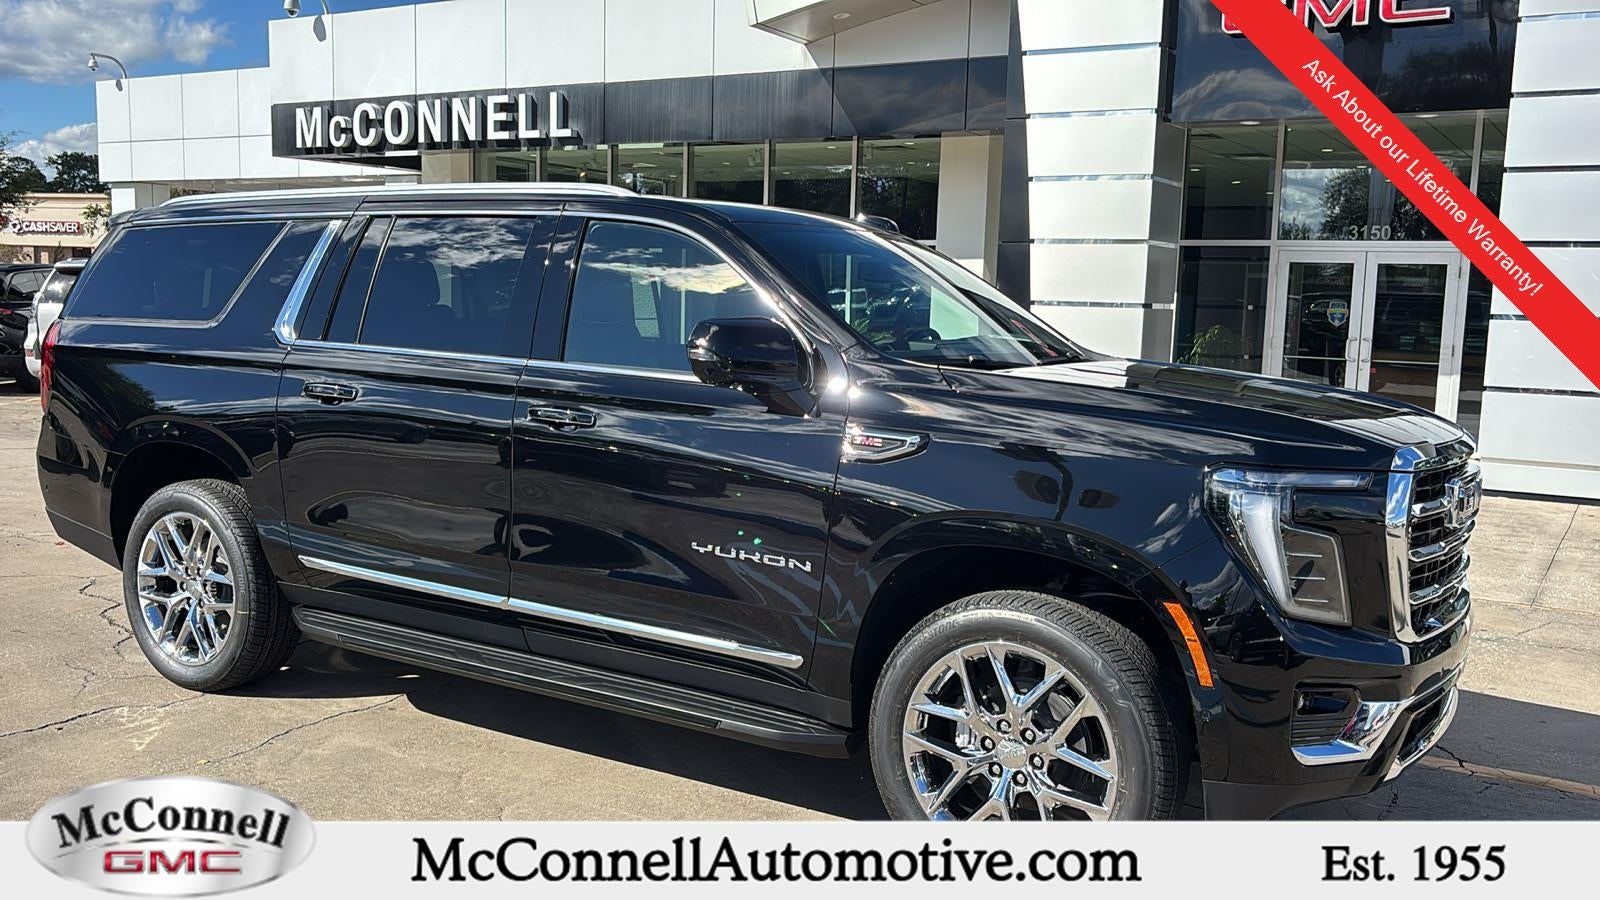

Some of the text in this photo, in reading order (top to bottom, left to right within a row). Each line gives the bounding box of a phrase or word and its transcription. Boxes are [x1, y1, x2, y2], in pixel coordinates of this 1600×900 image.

[1221, 0, 1451, 34] MC
[295, 91, 573, 149] McCONNELL
[1349, 225, 1391, 240] 3150
[691, 541, 812, 573] YUKON
